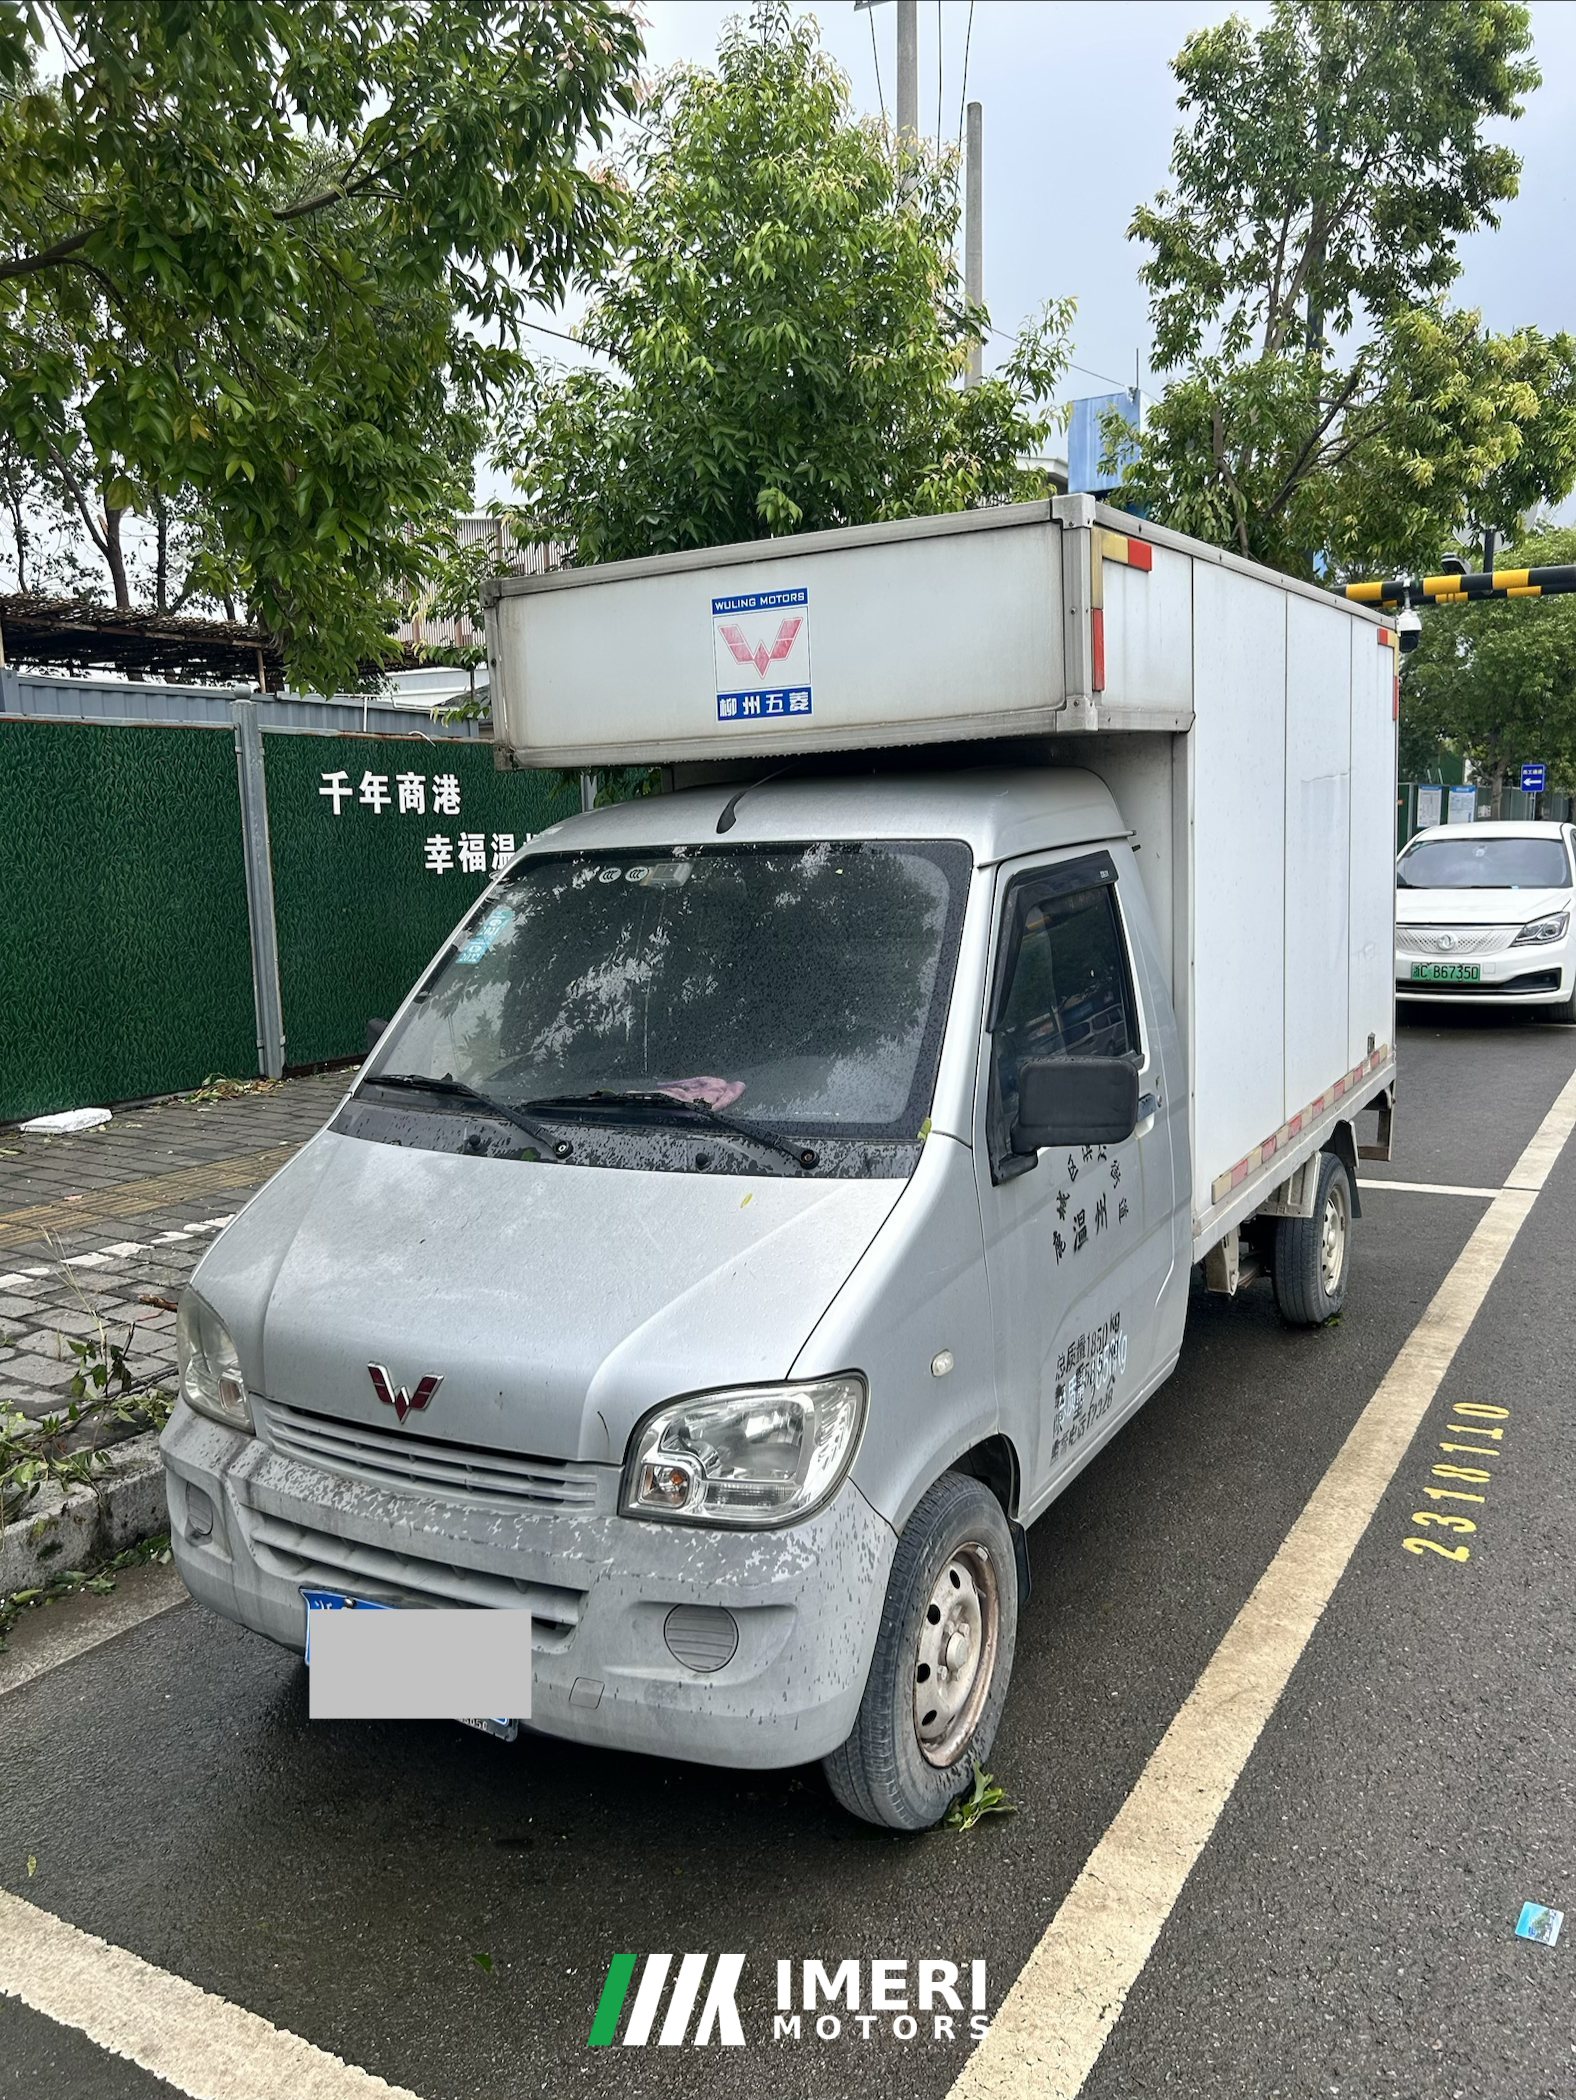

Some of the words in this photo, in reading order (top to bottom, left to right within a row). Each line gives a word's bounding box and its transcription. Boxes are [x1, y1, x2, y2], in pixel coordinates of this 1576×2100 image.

[715, 597, 757, 611] WULING
[760, 591, 805, 605] MOTORS
[719, 691, 809, 717] 柳州五菱
[319, 770, 461, 815] 千年商港
[424, 832, 538, 874] 幸福温
